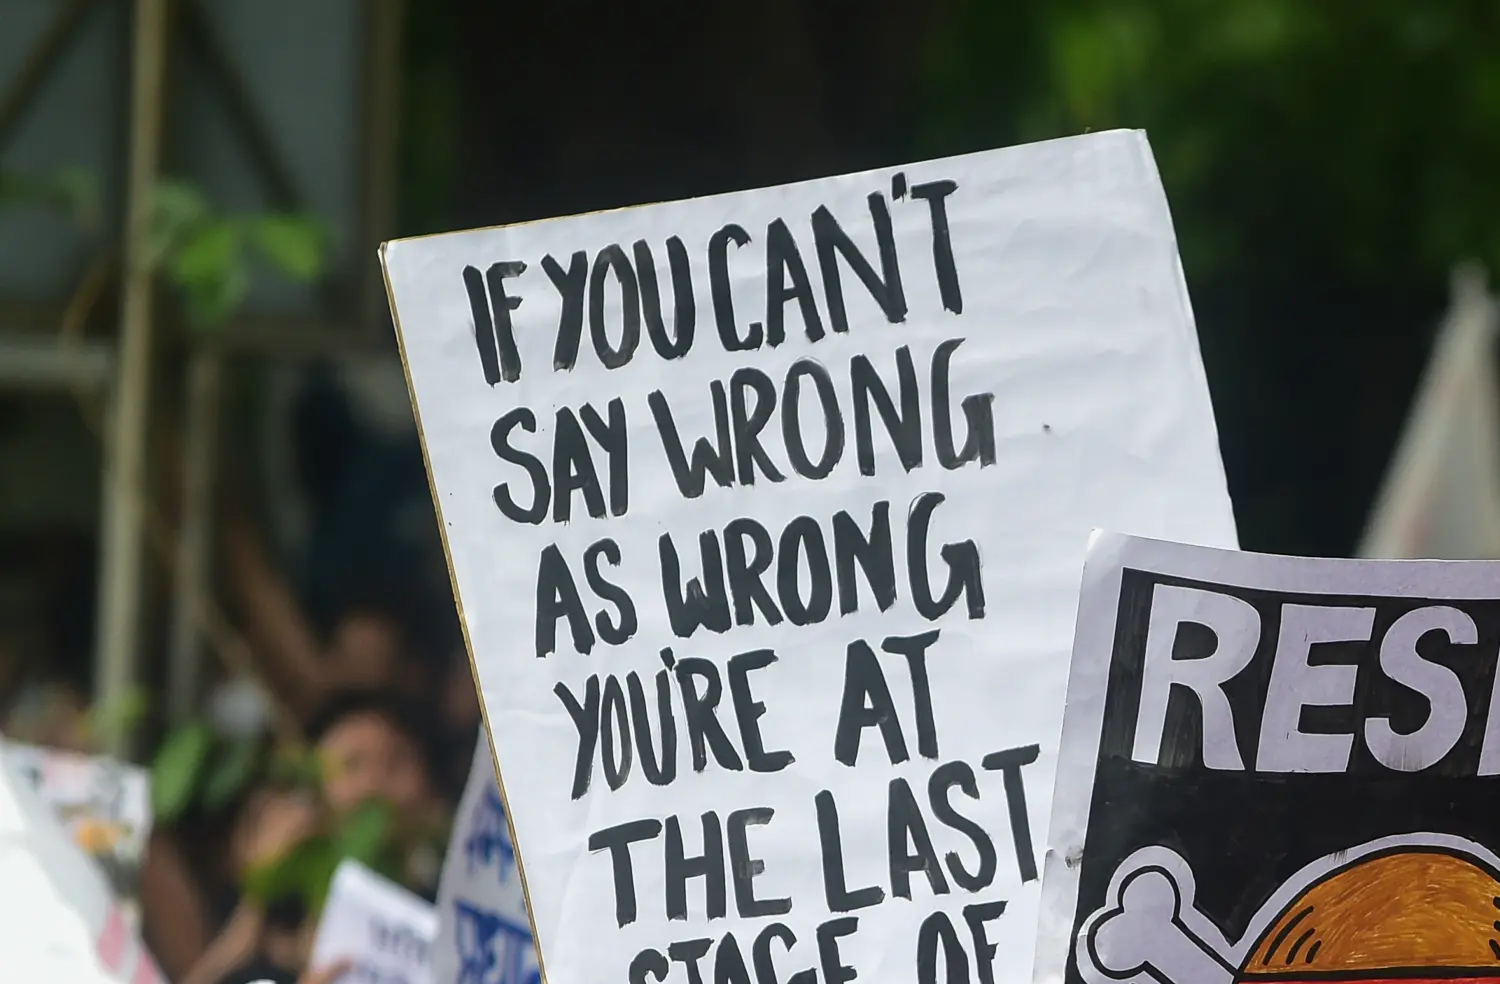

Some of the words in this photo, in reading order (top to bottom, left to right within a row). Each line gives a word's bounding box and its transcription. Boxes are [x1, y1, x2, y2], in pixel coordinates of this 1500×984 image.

[462, 260, 528, 387] IF
[540, 234, 697, 371] YOU
[708, 171, 961, 352] CAN'T
[490, 397, 630, 527] SAY
[648, 337, 997, 500] WRONG
[535, 538, 640, 660] AS
[659, 491, 987, 640] WRONG
[552, 646, 797, 801] YOU'RE
[834, 628, 941, 768] AT
[588, 806, 794, 930] THE
[814, 743, 1042, 913] LAST
